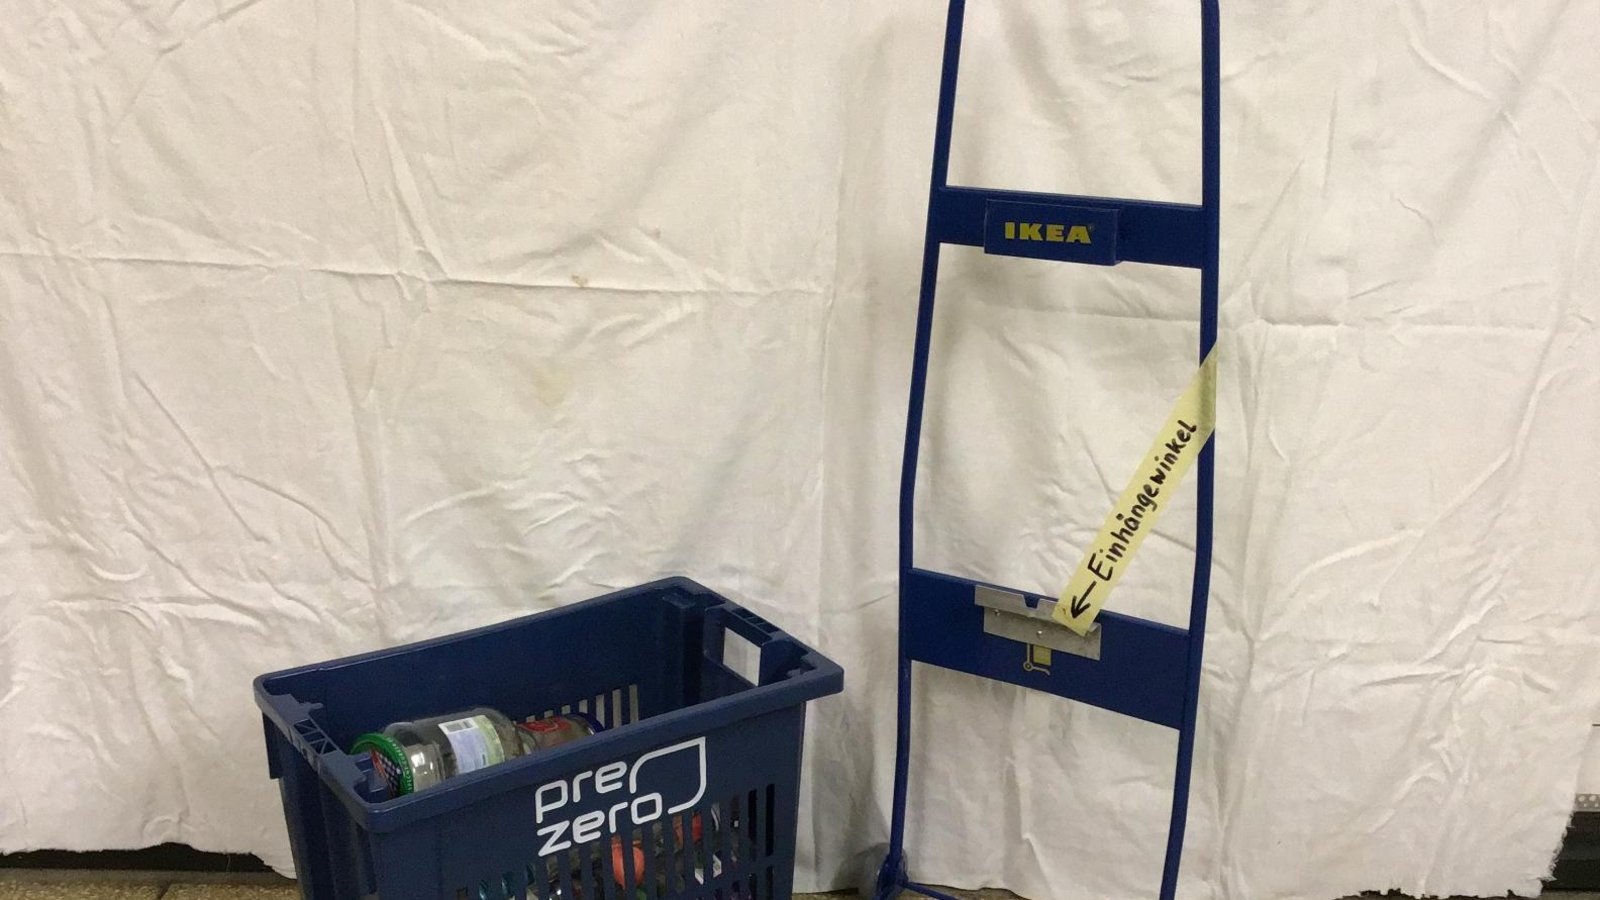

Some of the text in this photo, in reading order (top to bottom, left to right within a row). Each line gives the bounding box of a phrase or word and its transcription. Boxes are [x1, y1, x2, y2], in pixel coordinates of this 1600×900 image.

[1004, 221, 1092, 244] IKEA
[1087, 420, 1197, 581] Einhängewinkel
[535, 761, 628, 824] pre
[537, 792, 663, 857] zero
